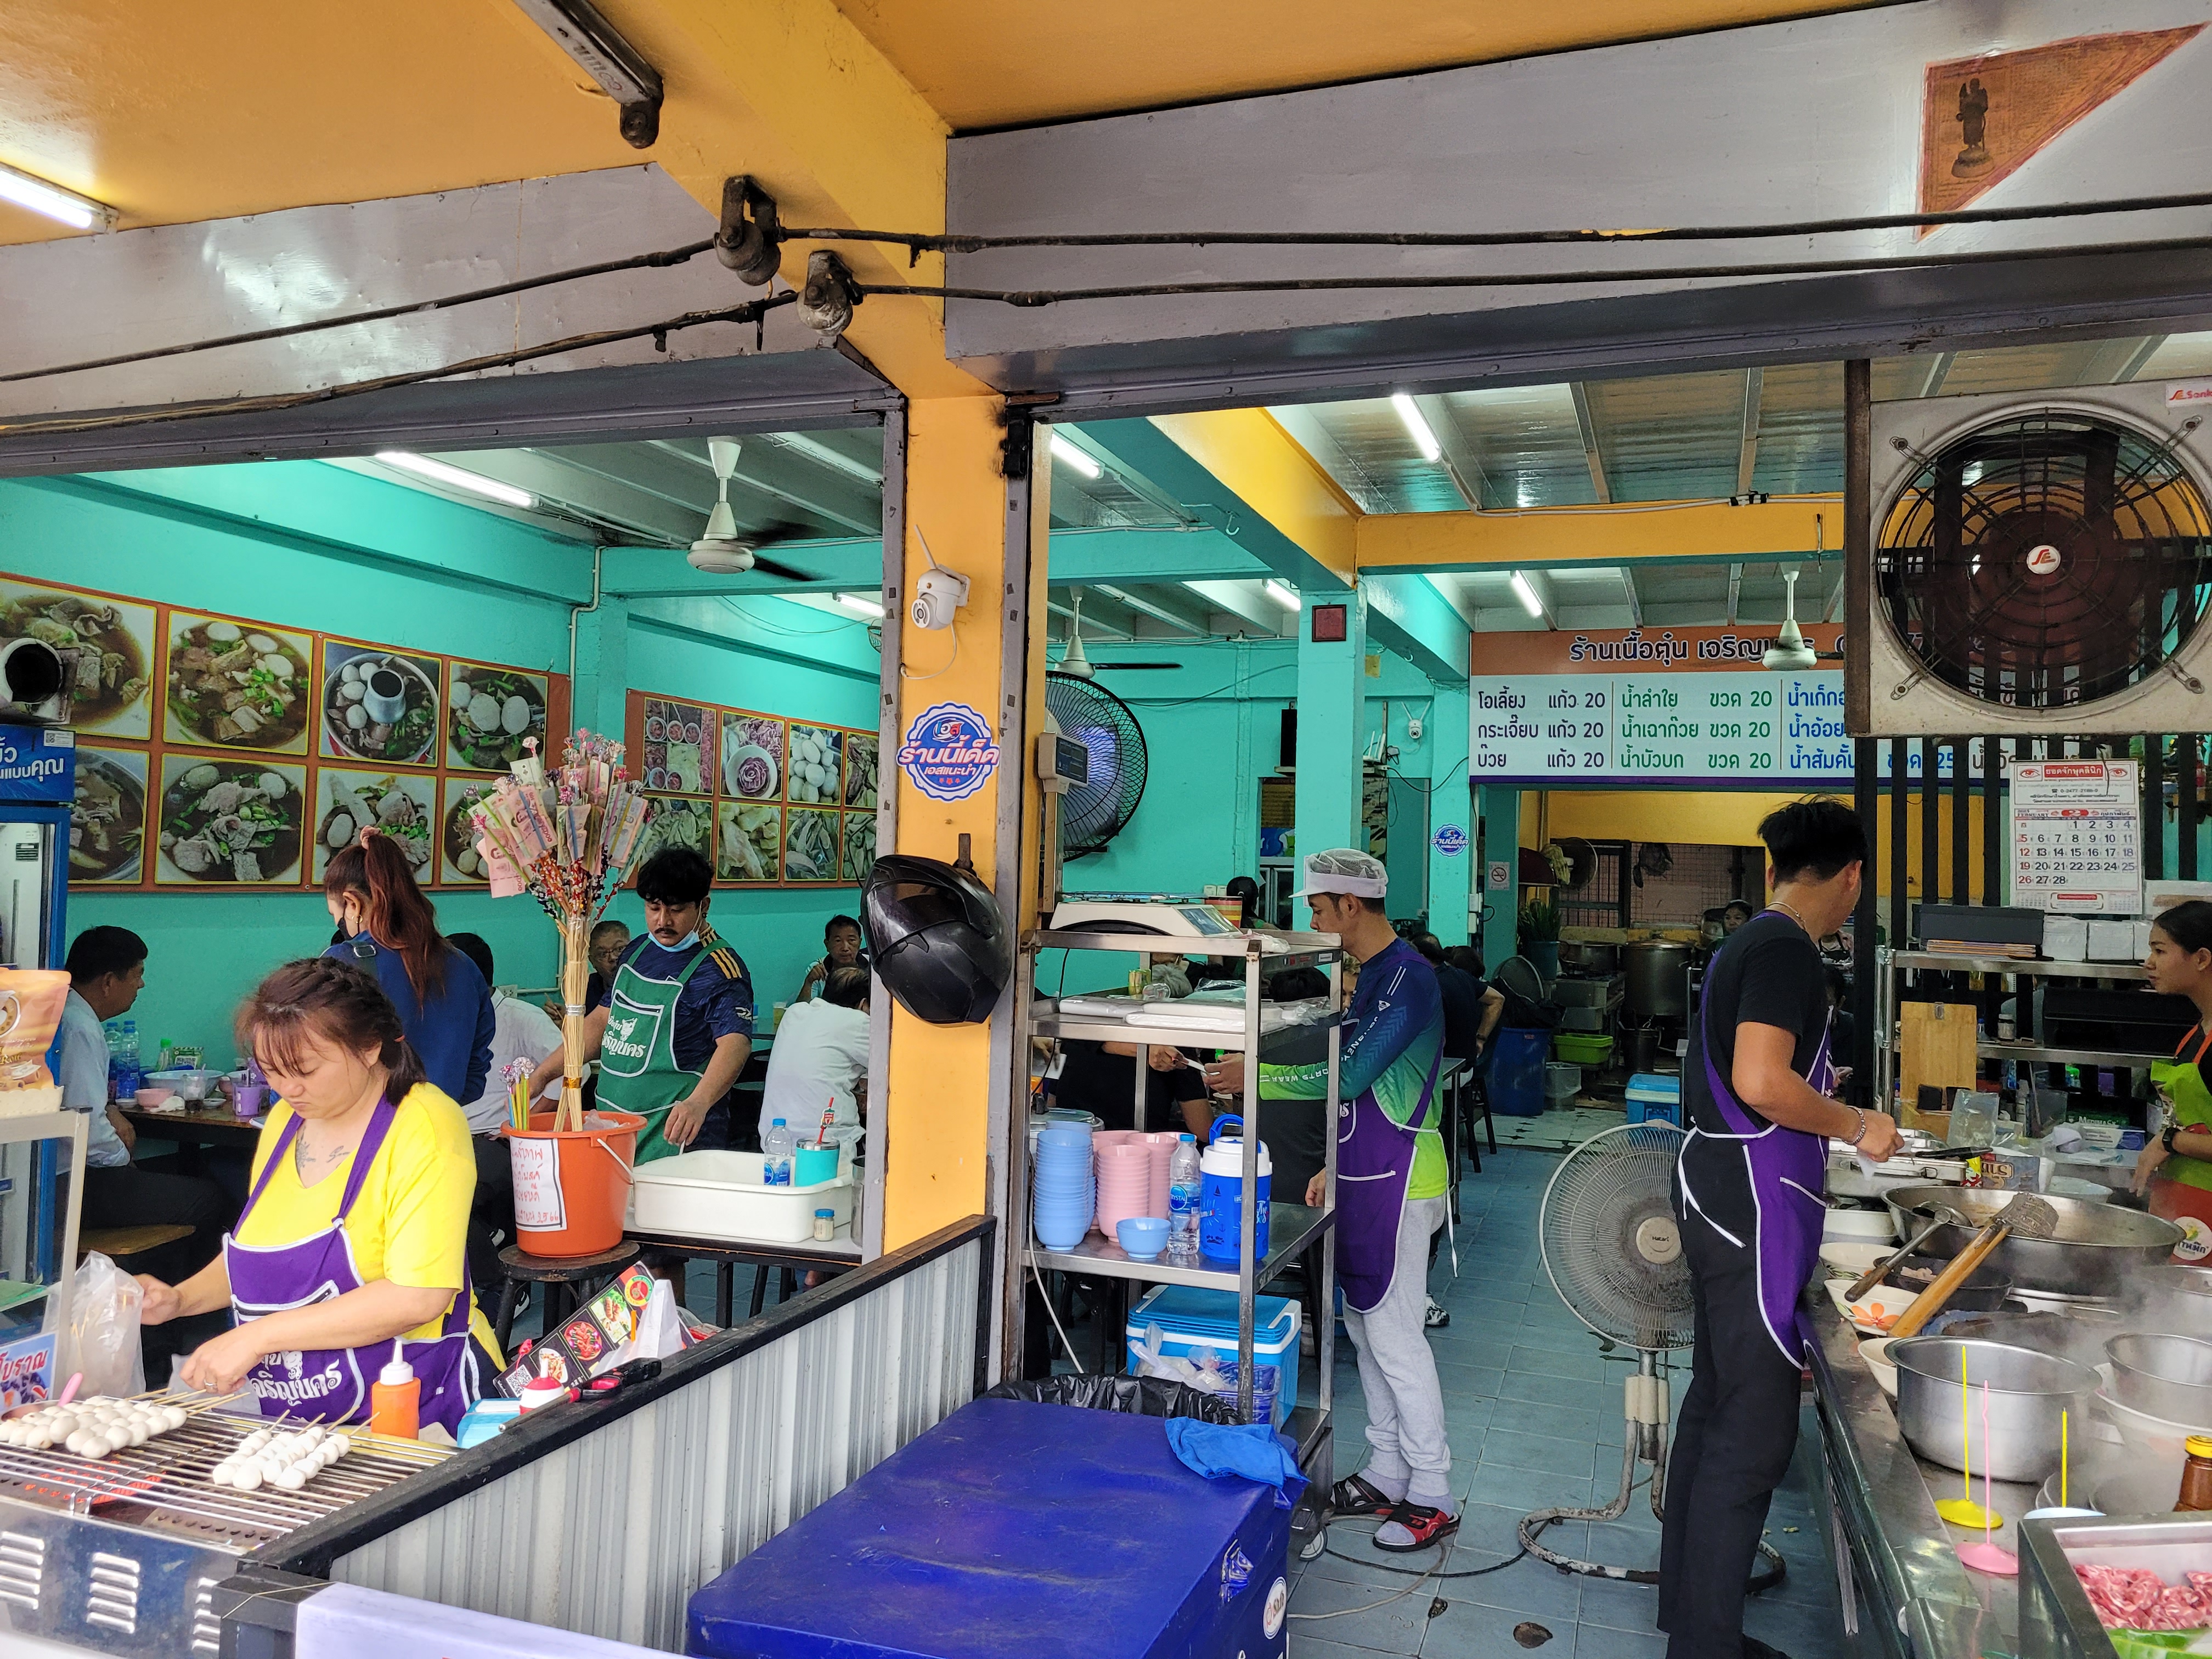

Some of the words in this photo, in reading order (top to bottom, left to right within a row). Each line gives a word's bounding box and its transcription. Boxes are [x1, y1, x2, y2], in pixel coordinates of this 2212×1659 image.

[2187, 388, 2212, 399] Sank
[1570, 630, 1689, 667] ร้านเนื้อตุ๋น
[1478, 686, 1526, 709] โอเลี้ยง
[1548, 689, 1577, 708] แก้ว
[1584, 692, 1605, 708] 20
[1750, 691, 1772, 707] 20
[1478, 714, 1539, 738] กระเจี๊ยบ
[1548, 719, 1576, 738] แก้ว
[1583, 723, 1604, 738] 20
[1622, 714, 1699, 738] น้ำเฉาก๊วย
[1748, 721, 1770, 737] 20
[899, 735, 999, 764] ร้านนี้เด็ด
[1477, 743, 1506, 768] บ๊วย
[1547, 748, 1576, 768] แก้ว
[1583, 752, 1604, 768] 20
[1621, 744, 1684, 768] น้ำบัวบก
[1750, 753, 1771, 769] 20
[924, 764, 977, 776] เอสแนะนำ
[2021, 834, 2027, 843] 5
[2038, 834, 2045, 843] 6
[2055, 834, 2062, 843] 7
[2072, 834, 2079, 843] 8
[2089, 834, 2096, 843] 9
[2104, 834, 2115, 843] 10
[2124, 834, 2132, 843] 11
[2019, 848, 2030, 856] 12
[2036, 848, 2047, 856] 13
[2053, 848, 2064, 856] 14
[2070, 848, 2081, 856] 15
[2087, 848, 2098, 856] 16
[2105, 848, 2115, 856] 17
[2124, 848, 2133, 856] 18
[2019, 862, 2030, 871] 19
[2035, 862, 2048, 871] 20
[2053, 862, 2065, 871] 21
[2069, 862, 2083, 871] 22
[2087, 862, 2100, 871] 23
[2103, 862, 2117, 871] 24
[2121, 862, 2135, 871] 25
[2018, 876, 2032, 884] 26
[2036, 876, 2049, 884] 27
[2053, 876, 2066, 884] 28
